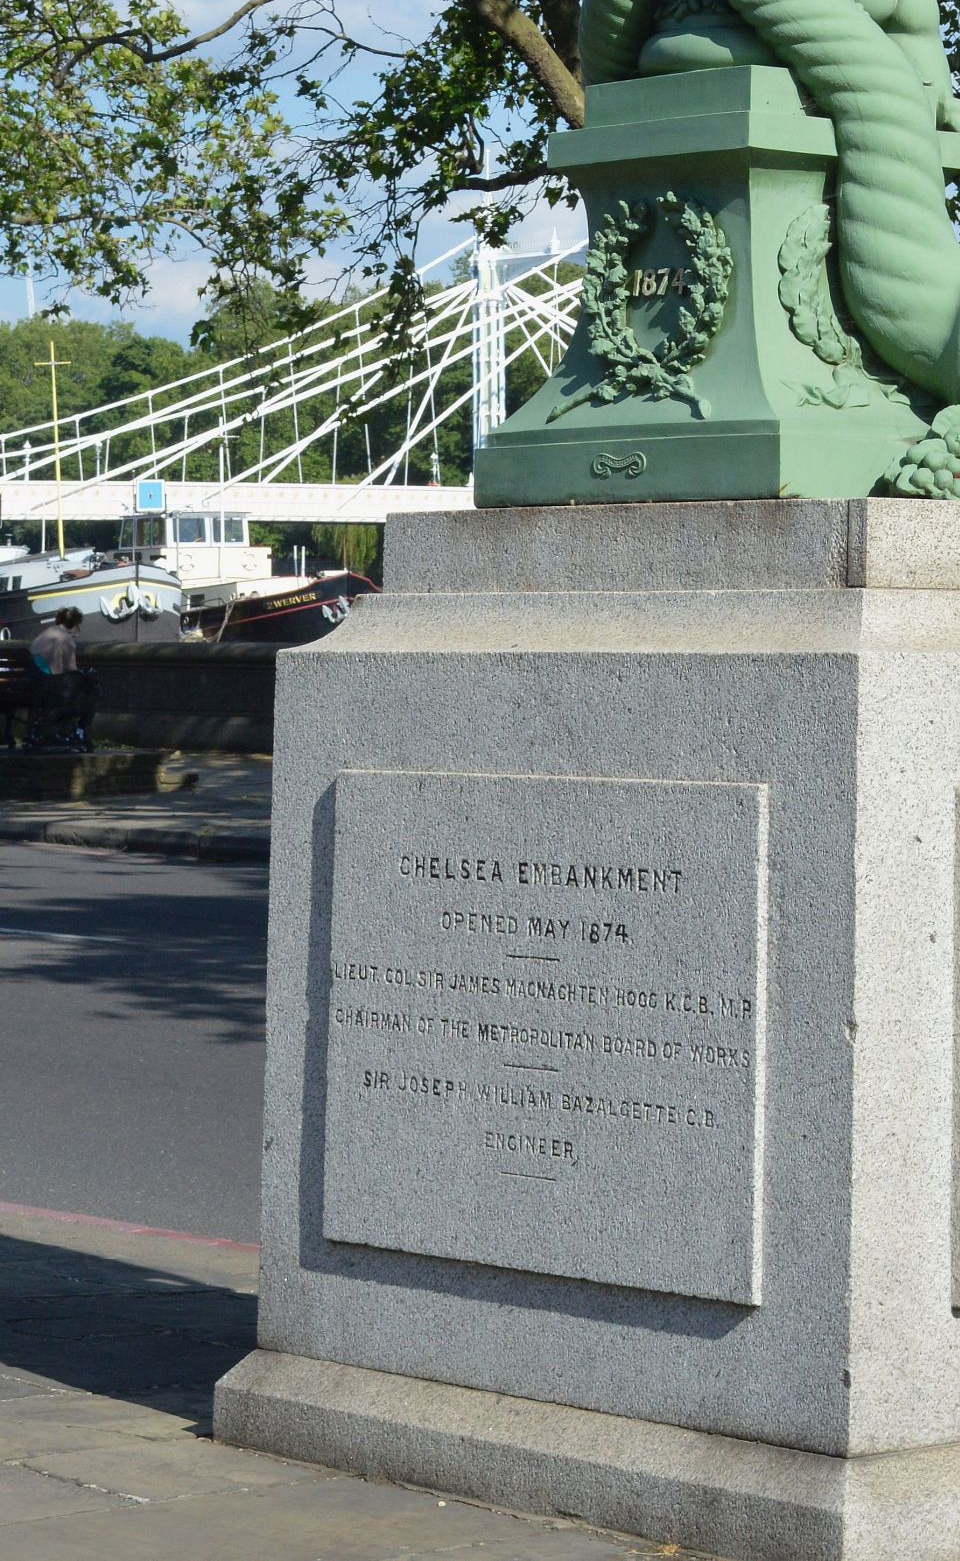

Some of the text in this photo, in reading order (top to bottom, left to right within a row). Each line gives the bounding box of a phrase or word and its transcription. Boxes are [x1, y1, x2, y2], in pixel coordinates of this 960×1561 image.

[632, 267, 686, 297] 1874
[400, 855, 682, 893] CHELSEA EMBANKMENT
[441, 911, 519, 935] OPENED
[528, 916, 570, 940] MAY
[417, 970, 444, 990] SIR
[449, 973, 501, 995] JAMES
[615, 989, 657, 1009] HOGG
[335, 1009, 751, 1068] CHAIRMAN OF THE METROPOLITAN BOARD OF WORKS
[363, 1070, 390, 1090] SIR
[398, 1071, 467, 1099] JOSEPH
[477, 1084, 551, 1108] WILLIAM
[561, 1094, 676, 1124] BAZALGETTE
